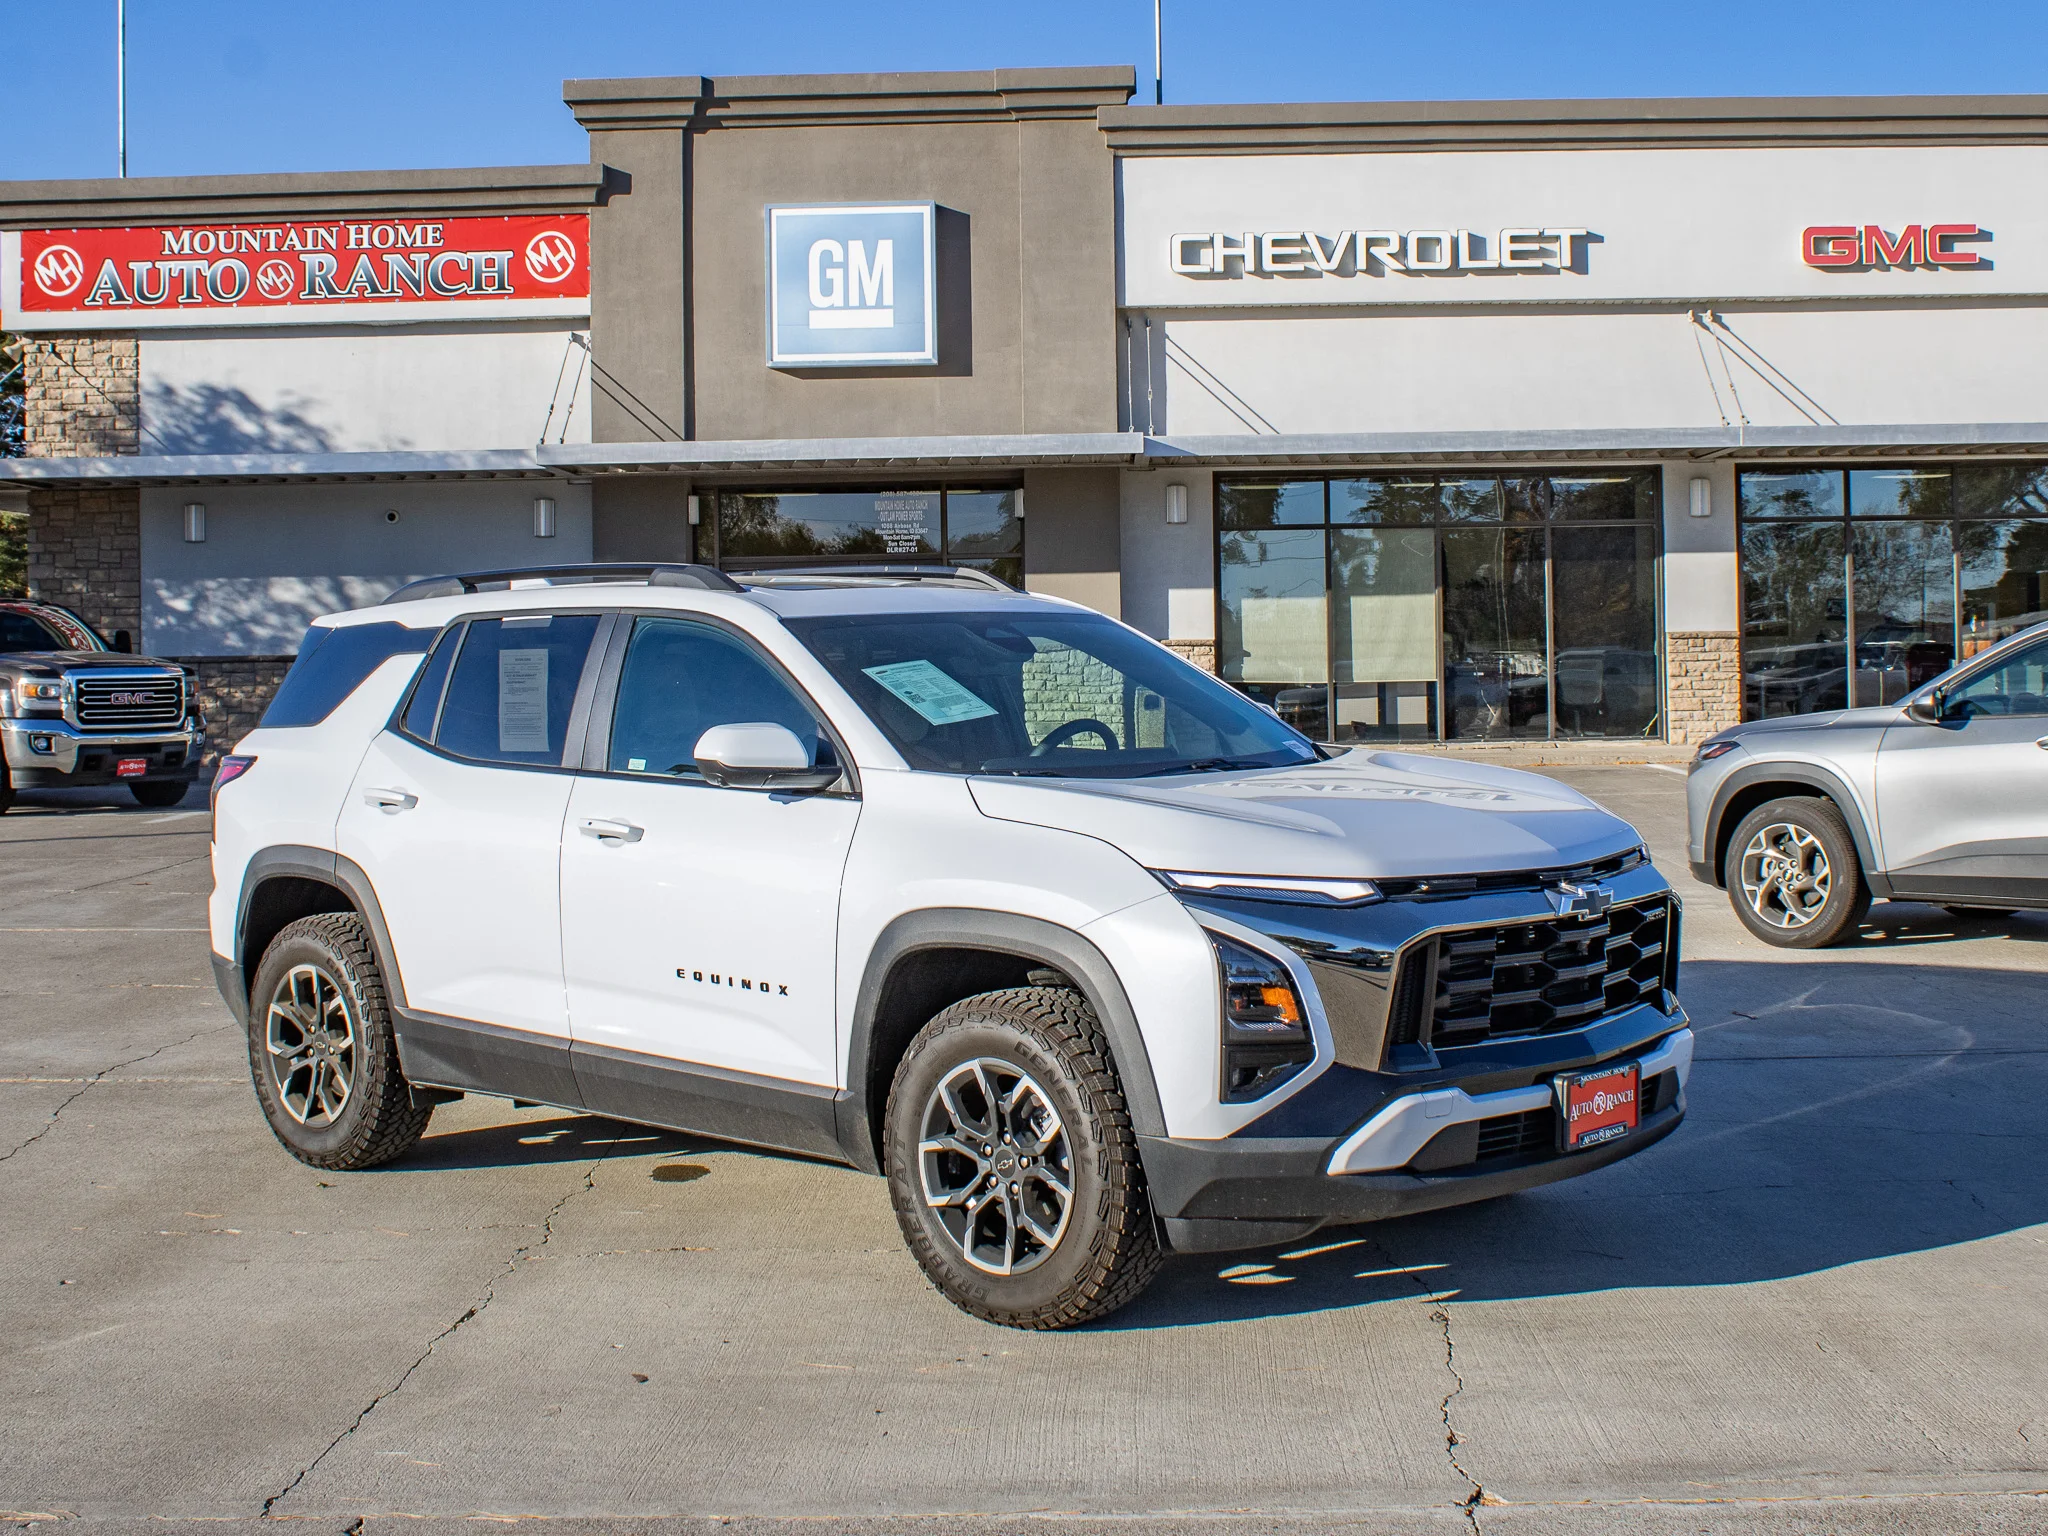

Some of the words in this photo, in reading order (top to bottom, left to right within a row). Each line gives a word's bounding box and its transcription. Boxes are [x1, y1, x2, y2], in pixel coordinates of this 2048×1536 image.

[161, 225, 338, 255] MOUNTAIN
[346, 223, 445, 250] HOME
[1170, 227, 1588, 274] CHEVROLET
[1802, 224, 1980, 265] GMC
[84, 257, 250, 305] AUTO
[298, 250, 514, 299] RANCH
[808, 239, 894, 308] GM
[111, 692, 154, 705] GMC
[676, 968, 789, 997] EQUINOX
[1580, 1069, 1612, 1082] MOUNTAIN
[1014, 1040, 1094, 1168] GENERAL
[1570, 1101, 1592, 1122] AUTO
[1606, 1089, 1634, 1112] RANCH
[1582, 1132, 1598, 1145] AUTO
[1605, 1125, 1624, 1138] RANCH
[902, 1196, 987, 1300] GRABBER
